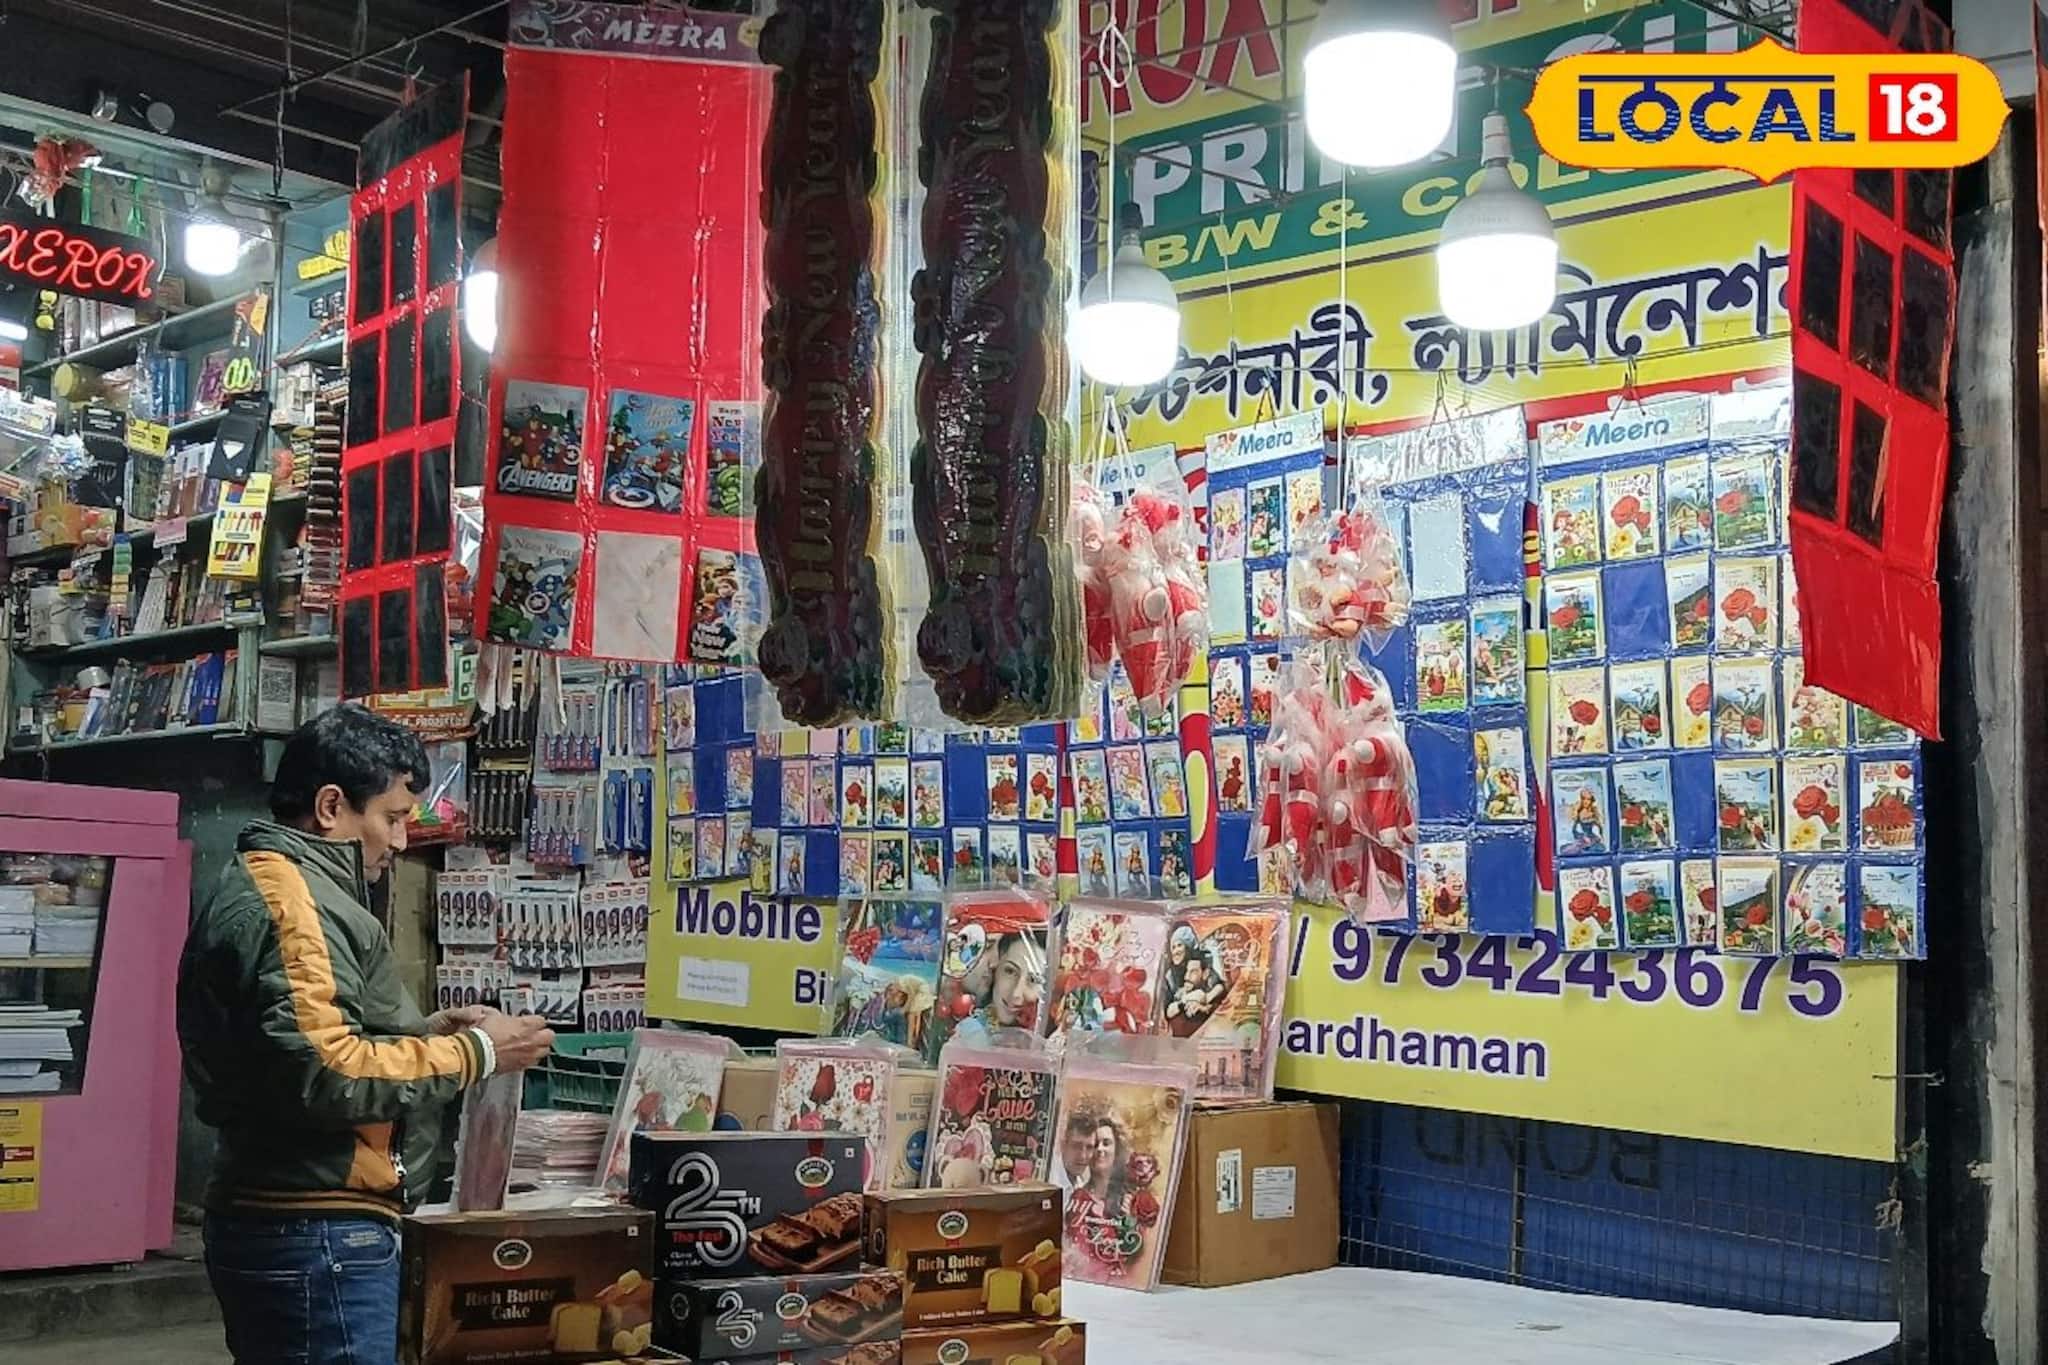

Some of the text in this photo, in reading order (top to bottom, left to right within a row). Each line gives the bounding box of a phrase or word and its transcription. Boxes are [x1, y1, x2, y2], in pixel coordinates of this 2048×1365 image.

[603, 19, 727, 50] MEERA
[0, 224, 156, 298] XEROX
[1144, 212, 1282, 270] B/W
[1309, 198, 1369, 237] &
[1238, 427, 1294, 456] Meera
[1585, 418, 1670, 448] Meera
[498, 462, 578, 493] AVENGERS
[675, 887, 821, 942] Mobile
[1332, 919, 1843, 1016] 9734243675
[1279, 1016, 1547, 1077] ardhaman
